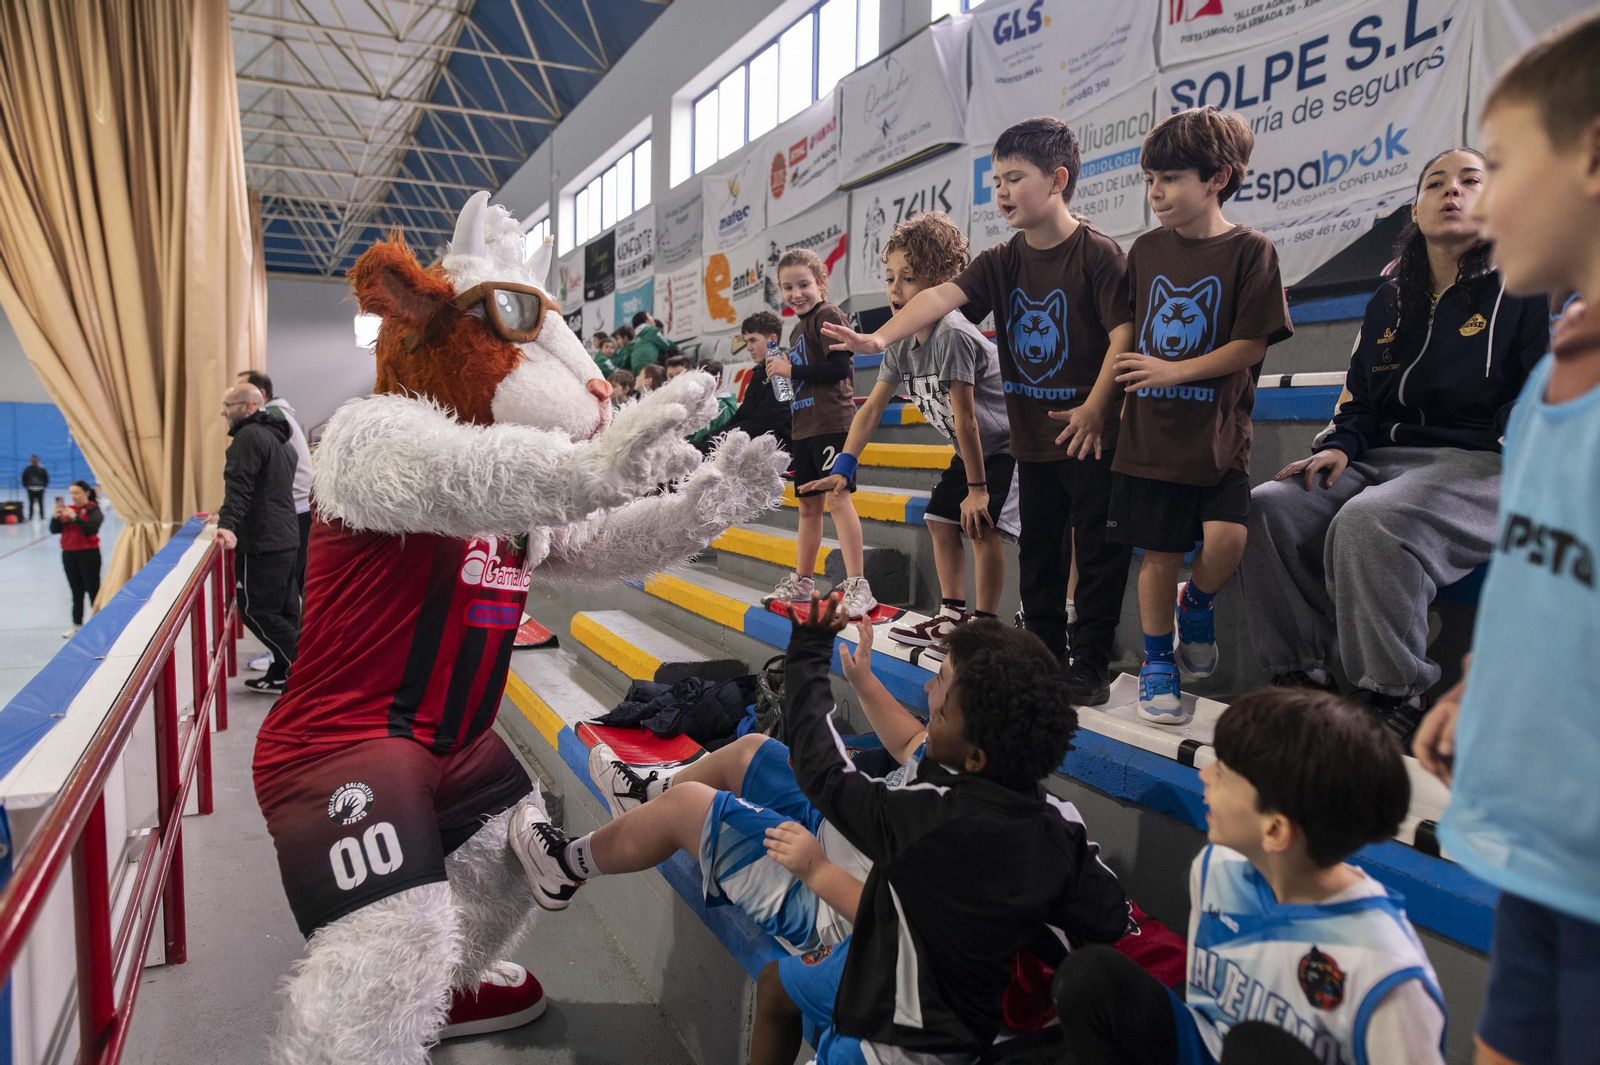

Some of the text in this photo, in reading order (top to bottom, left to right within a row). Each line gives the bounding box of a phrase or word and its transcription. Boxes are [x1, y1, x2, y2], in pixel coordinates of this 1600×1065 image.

[1234, 4, 1263, 20] TALLER
[1248, 9, 1283, 28] ARMADA
[1171, 35, 1329, 114] SOLPE
[1345, 0, 1453, 71] S.L.
[1292, 97, 1323, 125] de
[1333, 46, 1445, 112] seguros
[1080, 153, 1142, 178] UDIOLOGI
[1233, 122, 1411, 203] Espabrok
[1339, 162, 1409, 192] CONFIANZA
[1106, 178, 1119, 192] DE
[329, 822, 404, 891] 00
